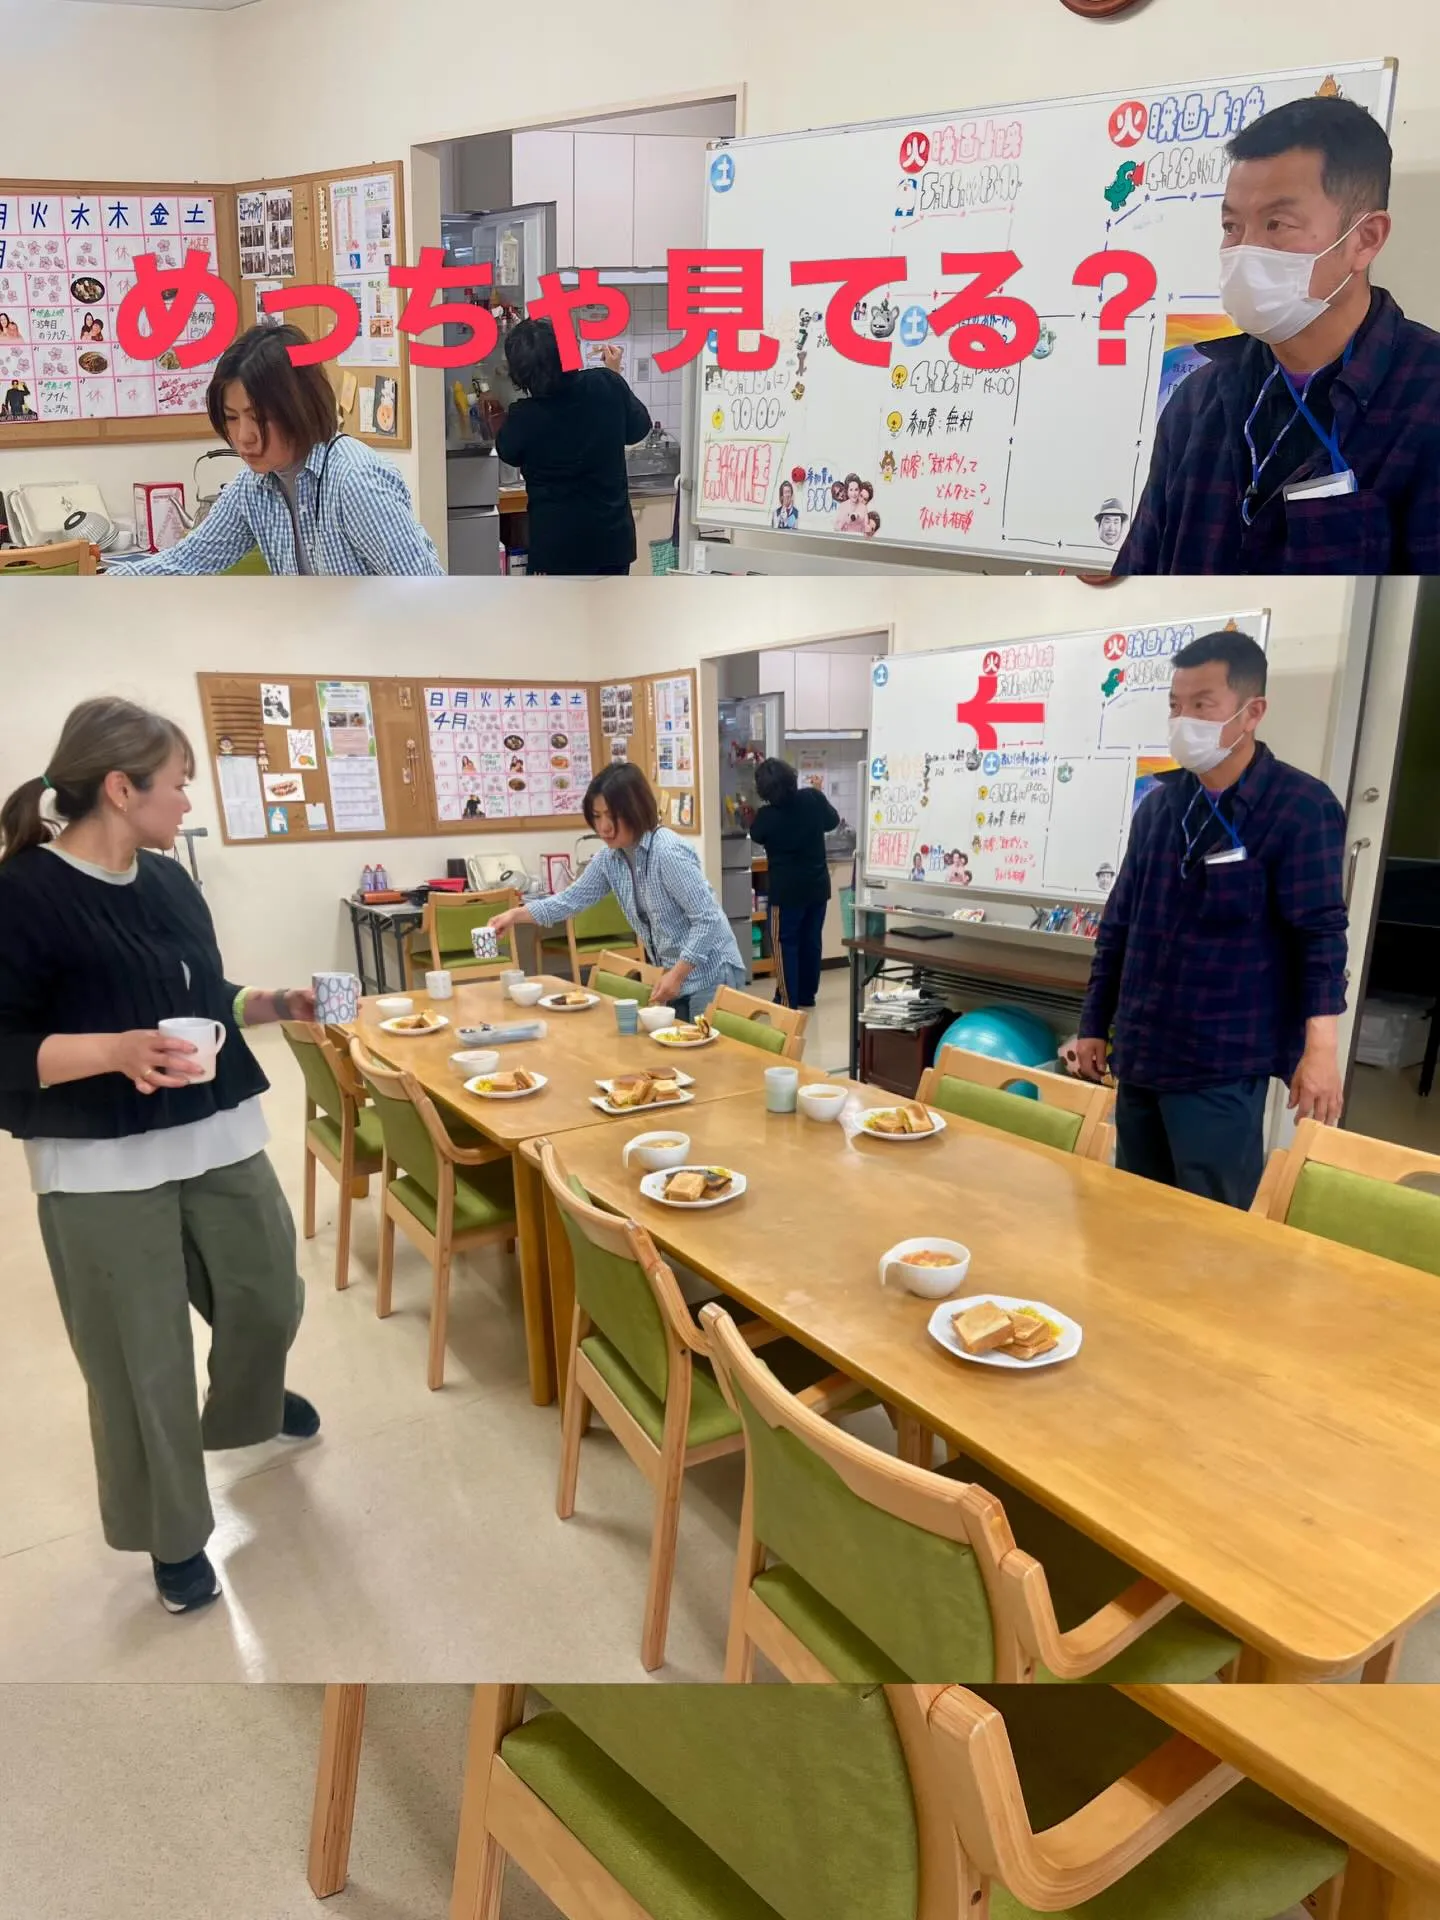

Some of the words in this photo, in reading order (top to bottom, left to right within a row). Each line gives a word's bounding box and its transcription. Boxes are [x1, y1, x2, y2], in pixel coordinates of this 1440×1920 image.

[1114, 108, 1142, 142] 火
[902, 136, 927, 168] 火
[715, 156, 731, 187] 土
[31, 201, 49, 230] 火
[107, 201, 129, 229] 木
[149, 202, 170, 226] 金
[183, 203, 206, 224] 土
[116, 246, 130, 260] 休
[903, 309, 923, 341] 土
[430, 692, 443, 706] 日
[454, 692, 468, 708] 月
[480, 691, 491, 707] 火
[525, 692, 538, 707] 木
[550, 692, 562, 706] 金
[570, 693, 582, 705] 土
[434, 712, 467, 730] 4月
